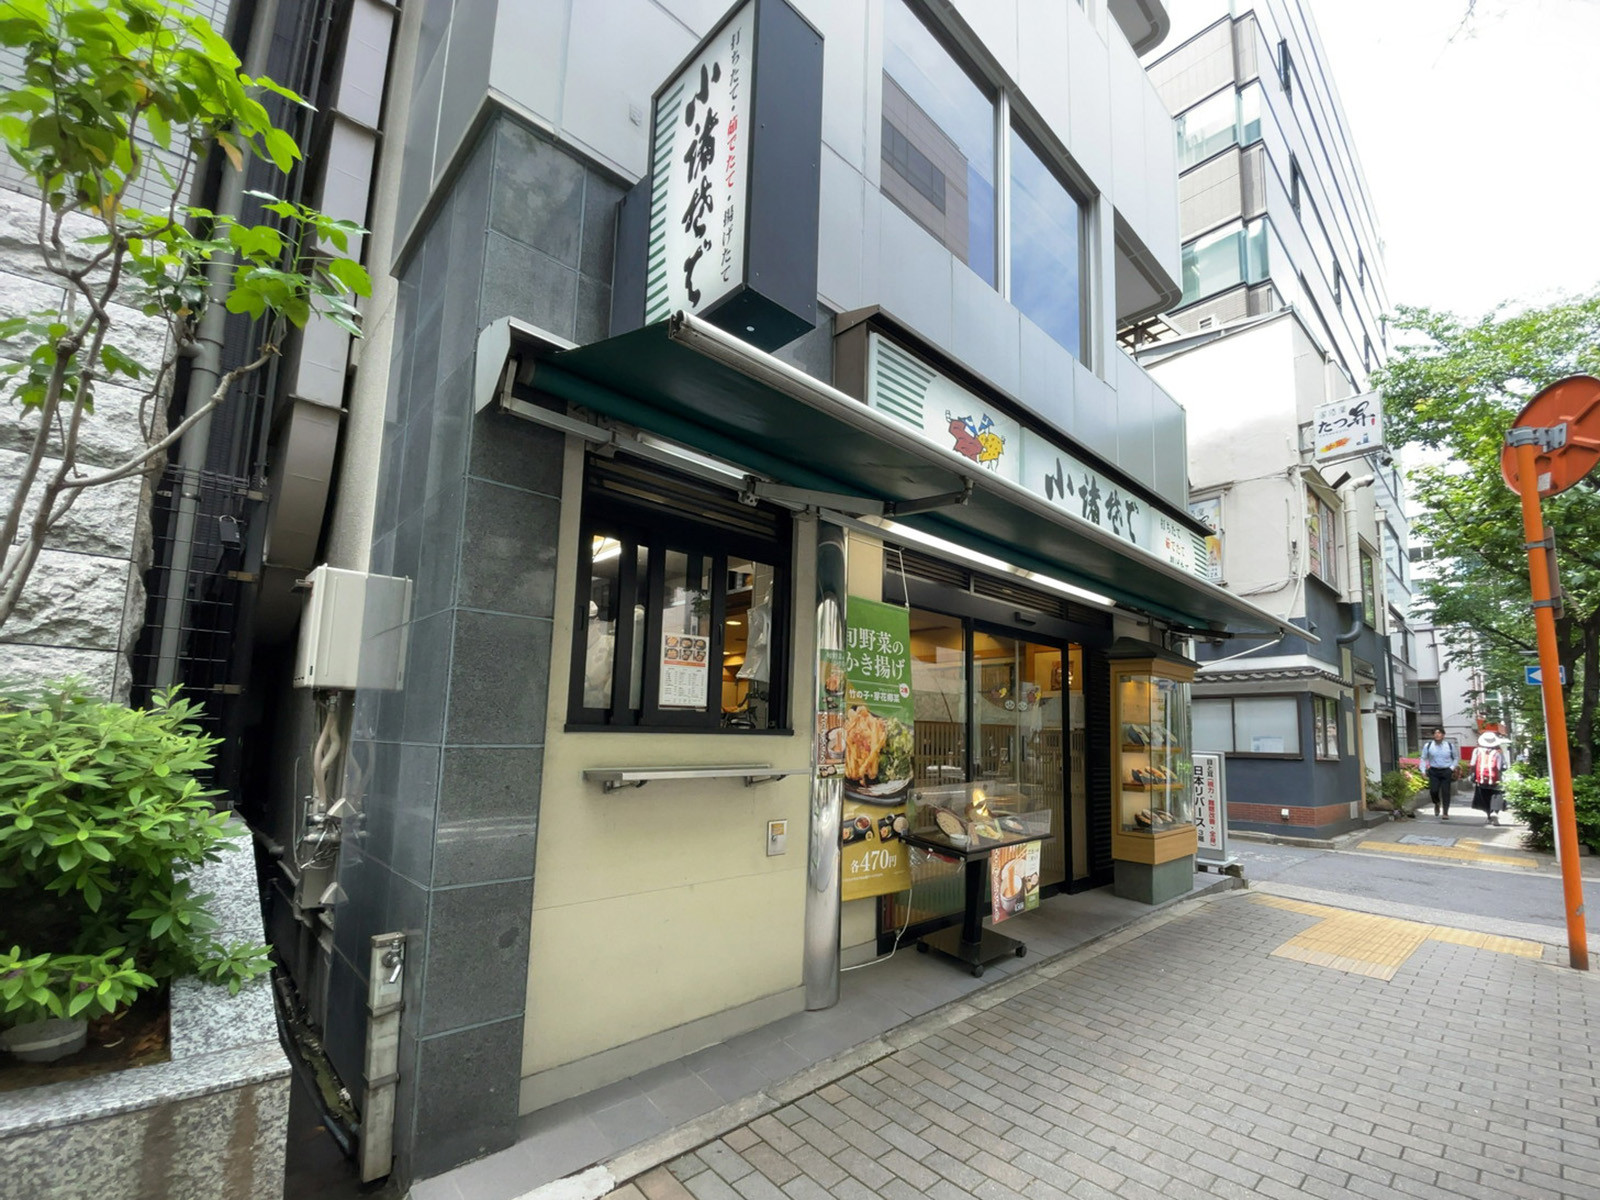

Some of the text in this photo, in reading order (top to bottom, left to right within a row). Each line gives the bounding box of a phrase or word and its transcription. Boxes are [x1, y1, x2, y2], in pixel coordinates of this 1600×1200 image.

[1194, 765, 1206, 828] 日本リバース
[851, 849, 897, 874] 各470円
